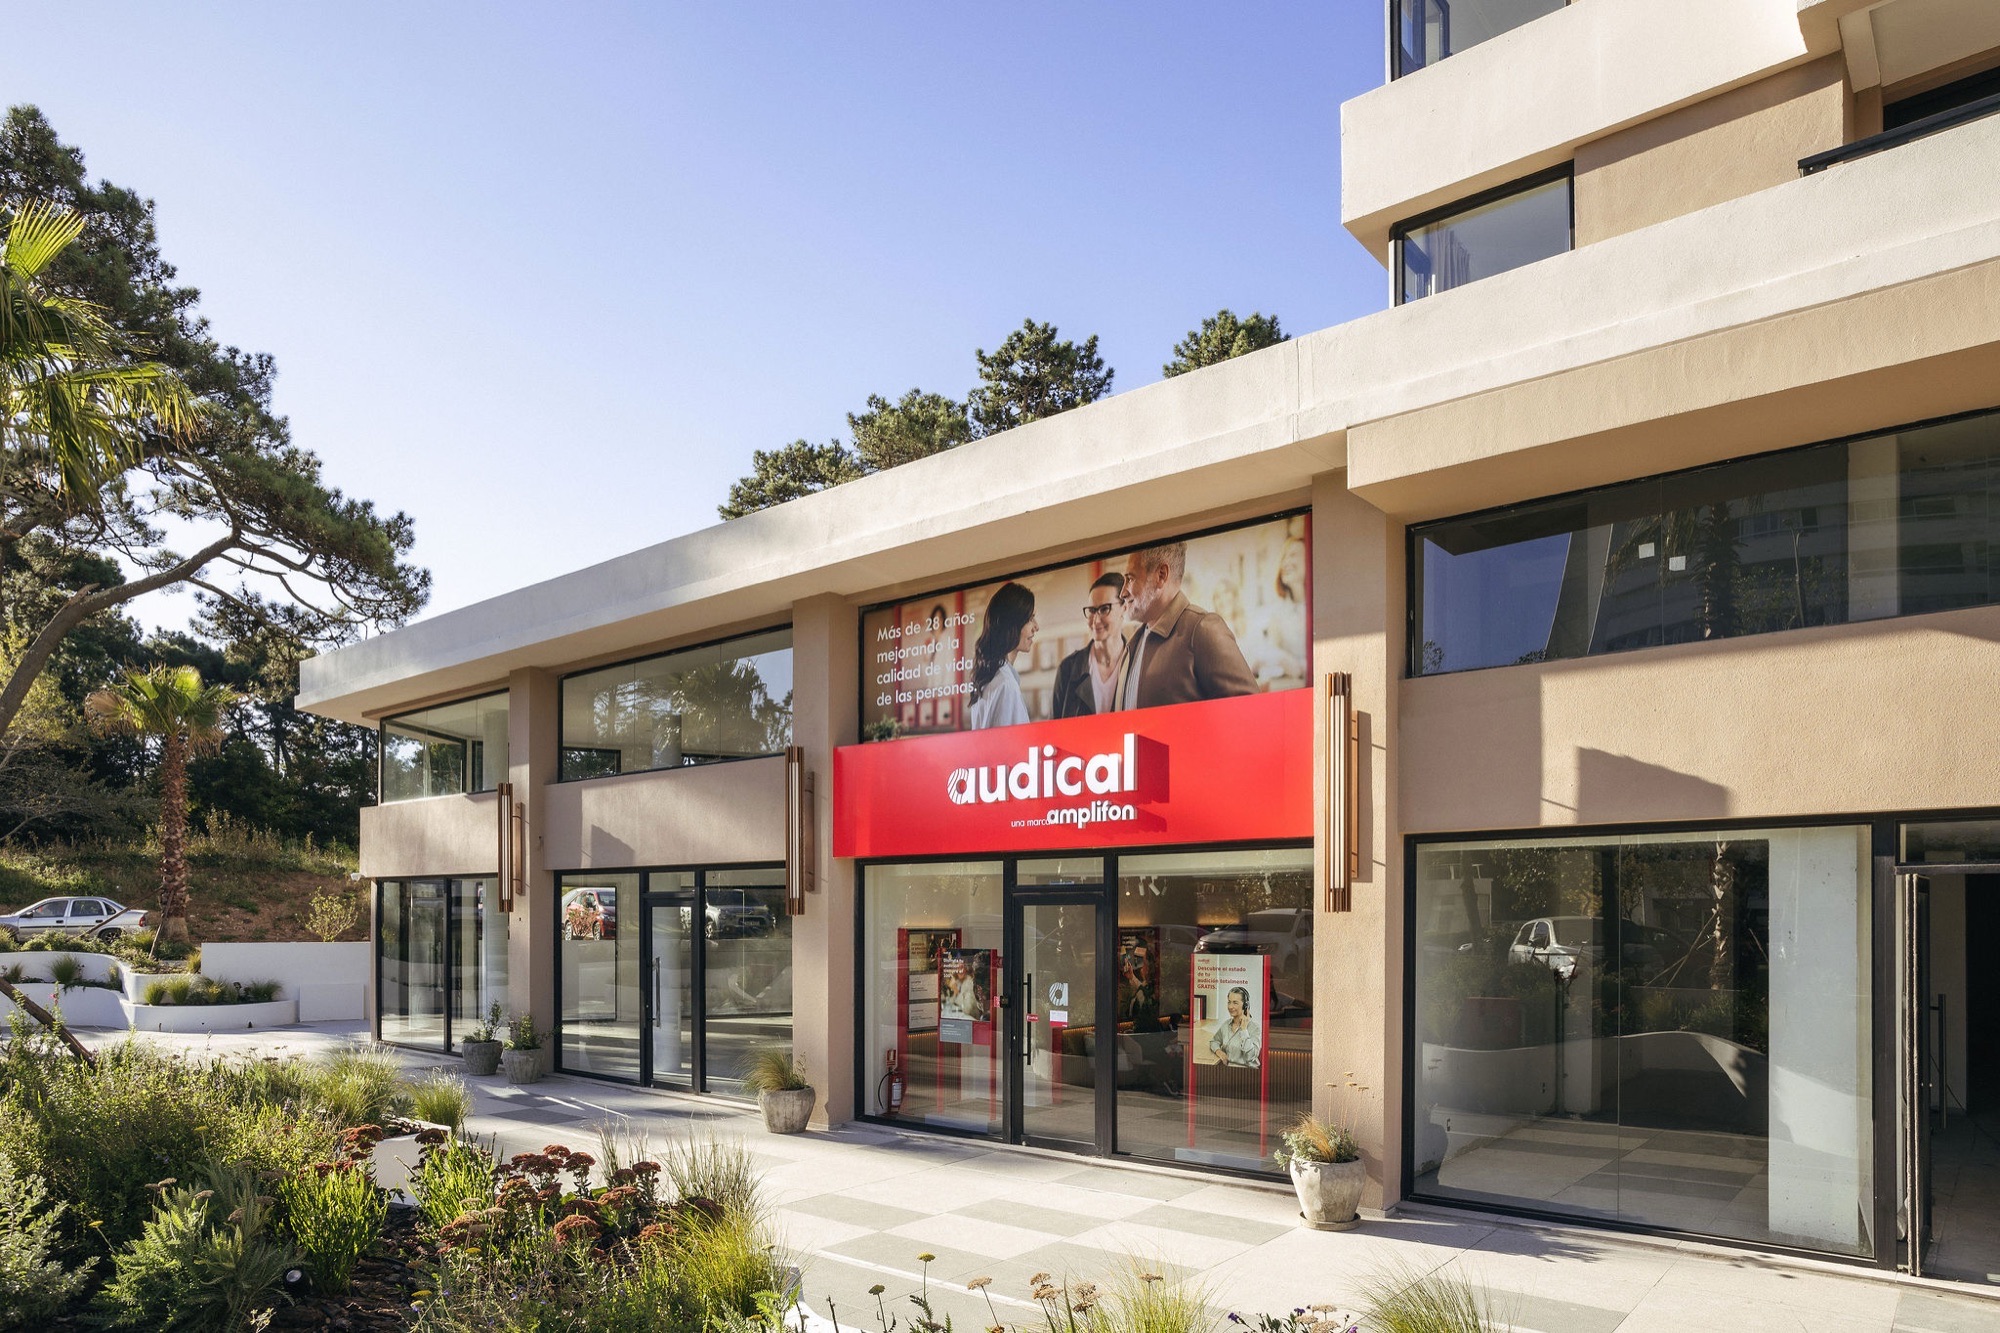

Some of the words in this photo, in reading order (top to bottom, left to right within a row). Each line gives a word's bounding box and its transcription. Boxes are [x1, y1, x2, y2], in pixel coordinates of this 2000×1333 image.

[877, 626, 901, 642] Más
[905, 621, 921, 636] de
[925, 617, 940, 632] 28
[944, 612, 975, 628] años
[877, 638, 943, 664] mejorando
[947, 636, 960, 650] la
[876, 665, 921, 685] calidad
[925, 661, 941, 676] de
[945, 656, 974, 673] vida
[876, 692, 892, 707] de
[895, 689, 912, 704] las
[916, 681, 978, 704] personas.
[947, 733, 1138, 805] audical
[1047, 800, 1137, 829] amplifon
